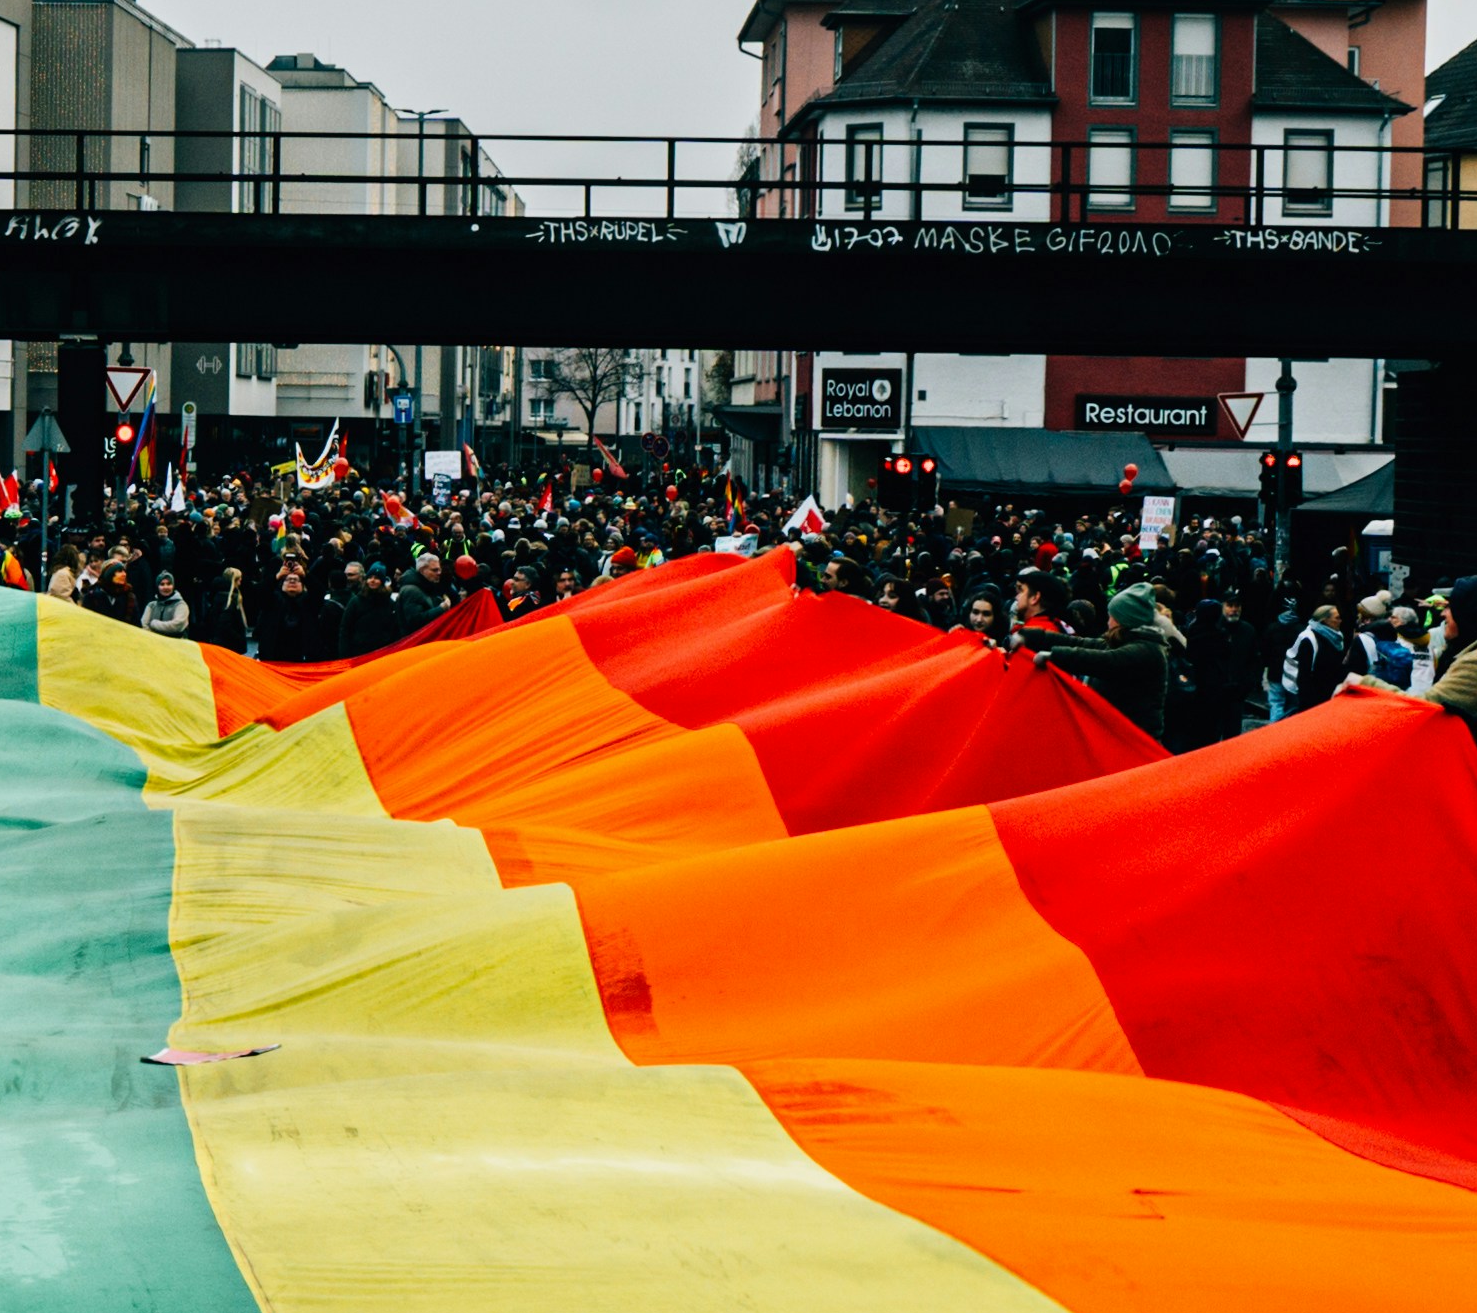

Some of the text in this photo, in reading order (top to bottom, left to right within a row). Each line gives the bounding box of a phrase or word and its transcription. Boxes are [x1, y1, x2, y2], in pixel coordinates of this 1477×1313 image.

[913, 225, 1036, 254] MASKE
[825, 379, 870, 400] Royal
[825, 400, 892, 419] Lebanon
[1085, 402, 1208, 426] Restaurant
